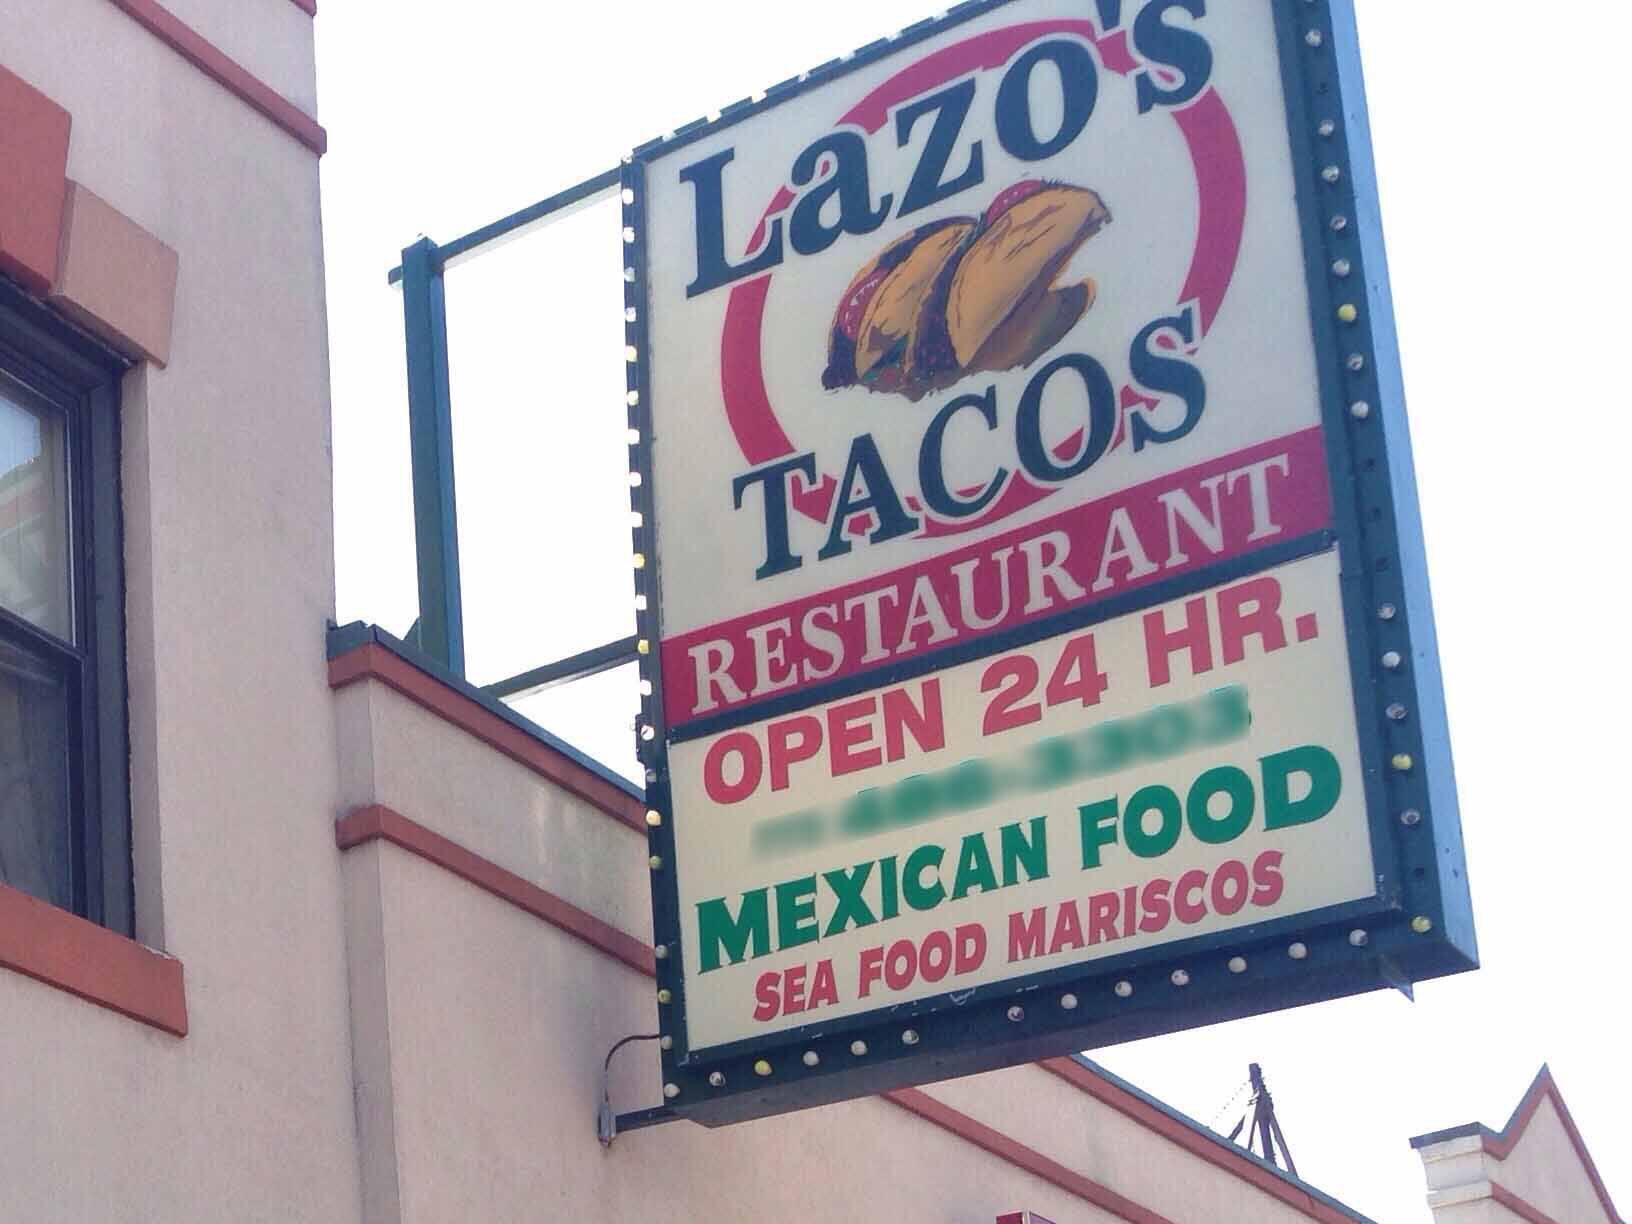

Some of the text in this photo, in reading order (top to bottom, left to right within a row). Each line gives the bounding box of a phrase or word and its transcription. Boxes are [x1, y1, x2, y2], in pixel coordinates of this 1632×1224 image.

[679, 0, 1214, 299] Lazo's
[732, 316, 1207, 581] TACOS
[687, 456, 1289, 715] RESTAURANT
[704, 679, 945, 804] OPEN
[981, 637, 1108, 736] 24
[1144, 576, 1319, 689] HR.
[696, 815, 1049, 975] MEXICAN
[1079, 744, 1343, 870] FOOD
[753, 850, 1285, 1023] SEA FOOD MARISCOS
